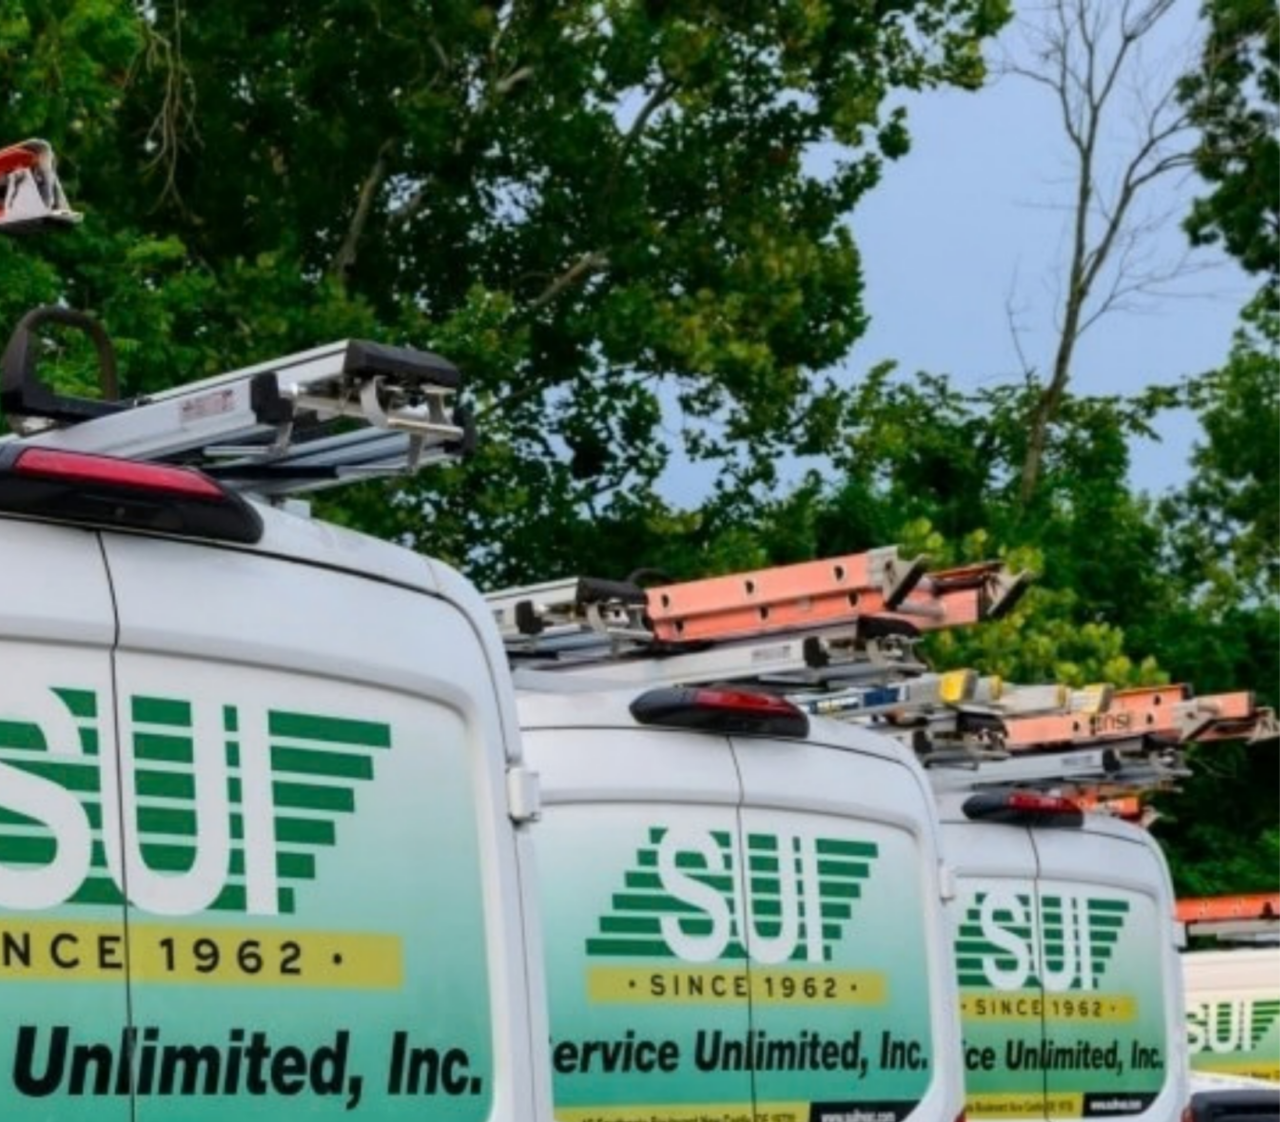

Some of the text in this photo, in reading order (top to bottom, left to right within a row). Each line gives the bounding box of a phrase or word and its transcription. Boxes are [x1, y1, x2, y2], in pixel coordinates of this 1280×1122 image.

[657, 827, 821, 963] SUI
[160, 935, 303, 975] 1962
[980, 892, 1095, 991] SUI
[650, 975, 837, 999] SINCE 1962
[975, 998, 1102, 1016] SINCE 1962
[11, 1024, 365, 1110] Unlimited,
[387, 1030, 482, 1097] Inc.
[552, 1030, 679, 1073] ervice
[694, 1030, 868, 1078] Unlimited,
[880, 1031, 928, 1071] Inc.
[1005, 1038, 1124, 1077] Unlimited,
[1131, 1038, 1164, 1070] Inc.
